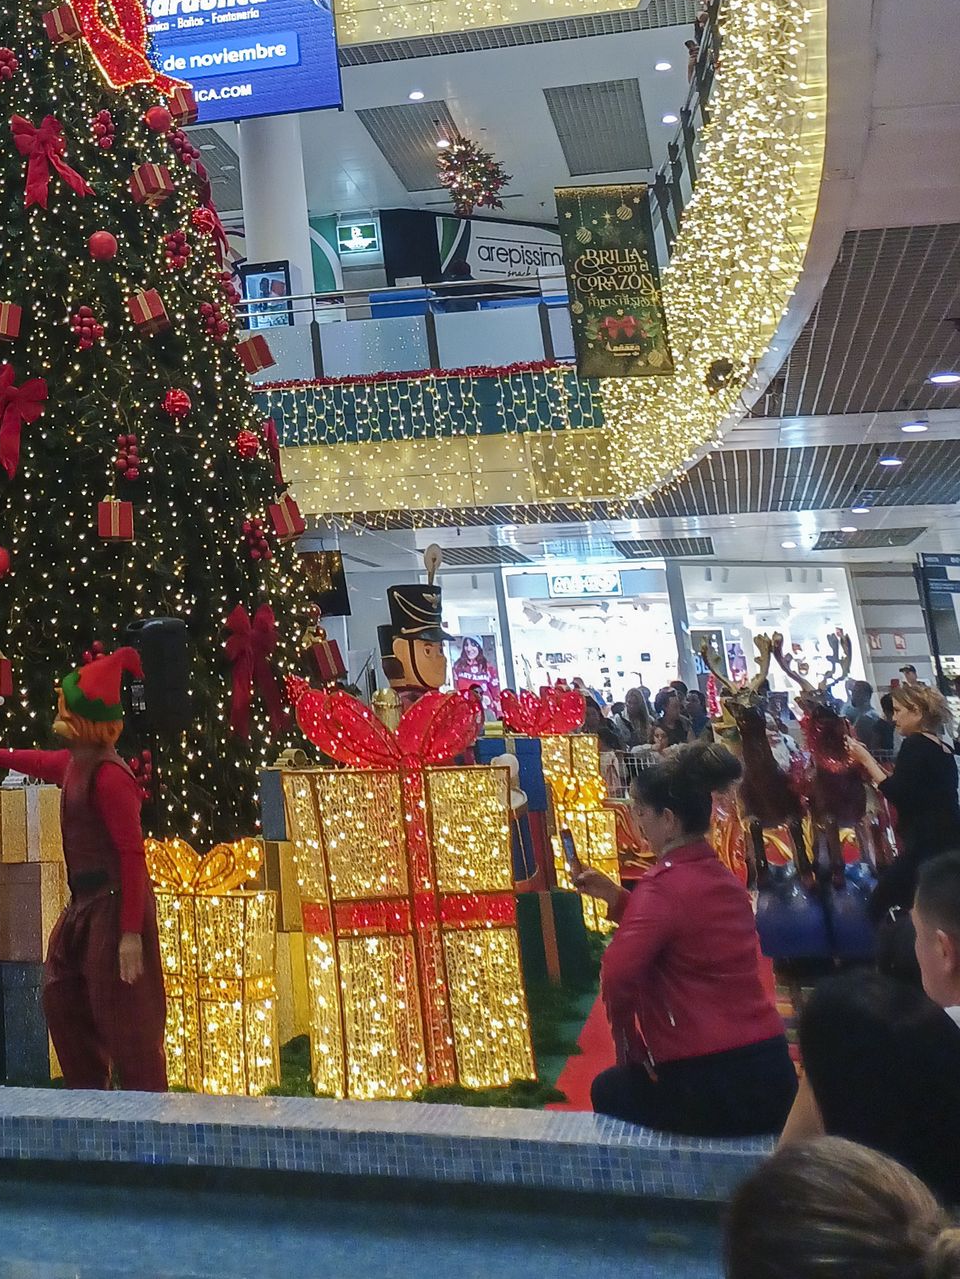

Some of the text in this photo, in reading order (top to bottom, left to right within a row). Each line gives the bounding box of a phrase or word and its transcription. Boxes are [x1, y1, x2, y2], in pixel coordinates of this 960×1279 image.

[147, 21, 170, 33] mica
[163, 42, 287, 71] de noviembre
[194, 83, 253, 102] ICA.COM
[477, 245, 562, 268] arepissim
[576, 248, 642, 272] BRILLA
[617, 259, 649, 273] con el
[577, 272, 656, 295] CORAZÓN
[694, 655, 711, 675] BL
